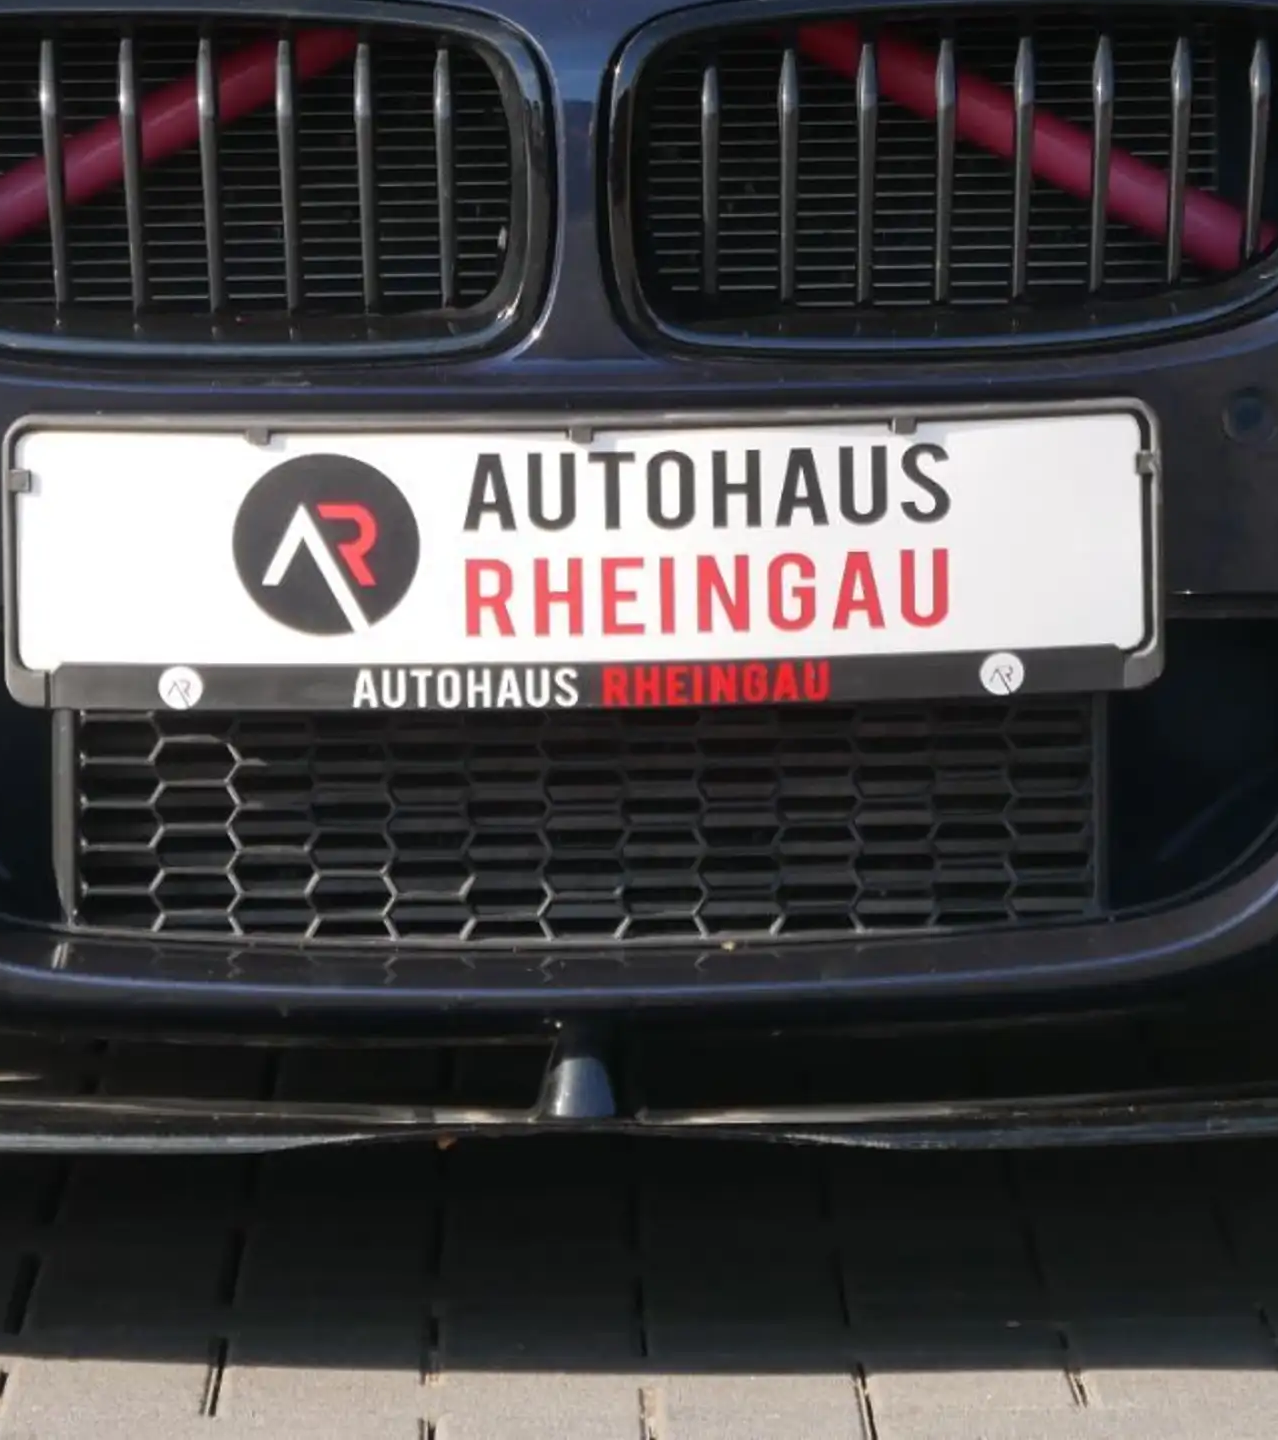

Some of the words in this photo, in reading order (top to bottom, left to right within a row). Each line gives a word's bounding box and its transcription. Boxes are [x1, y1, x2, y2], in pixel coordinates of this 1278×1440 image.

[463, 442, 952, 533] AUTOHAUS
[464, 548, 950, 638] RHEINGAU
[352, 666, 579, 709] AUTOHAUS
[601, 660, 830, 708] RHEINGAU
